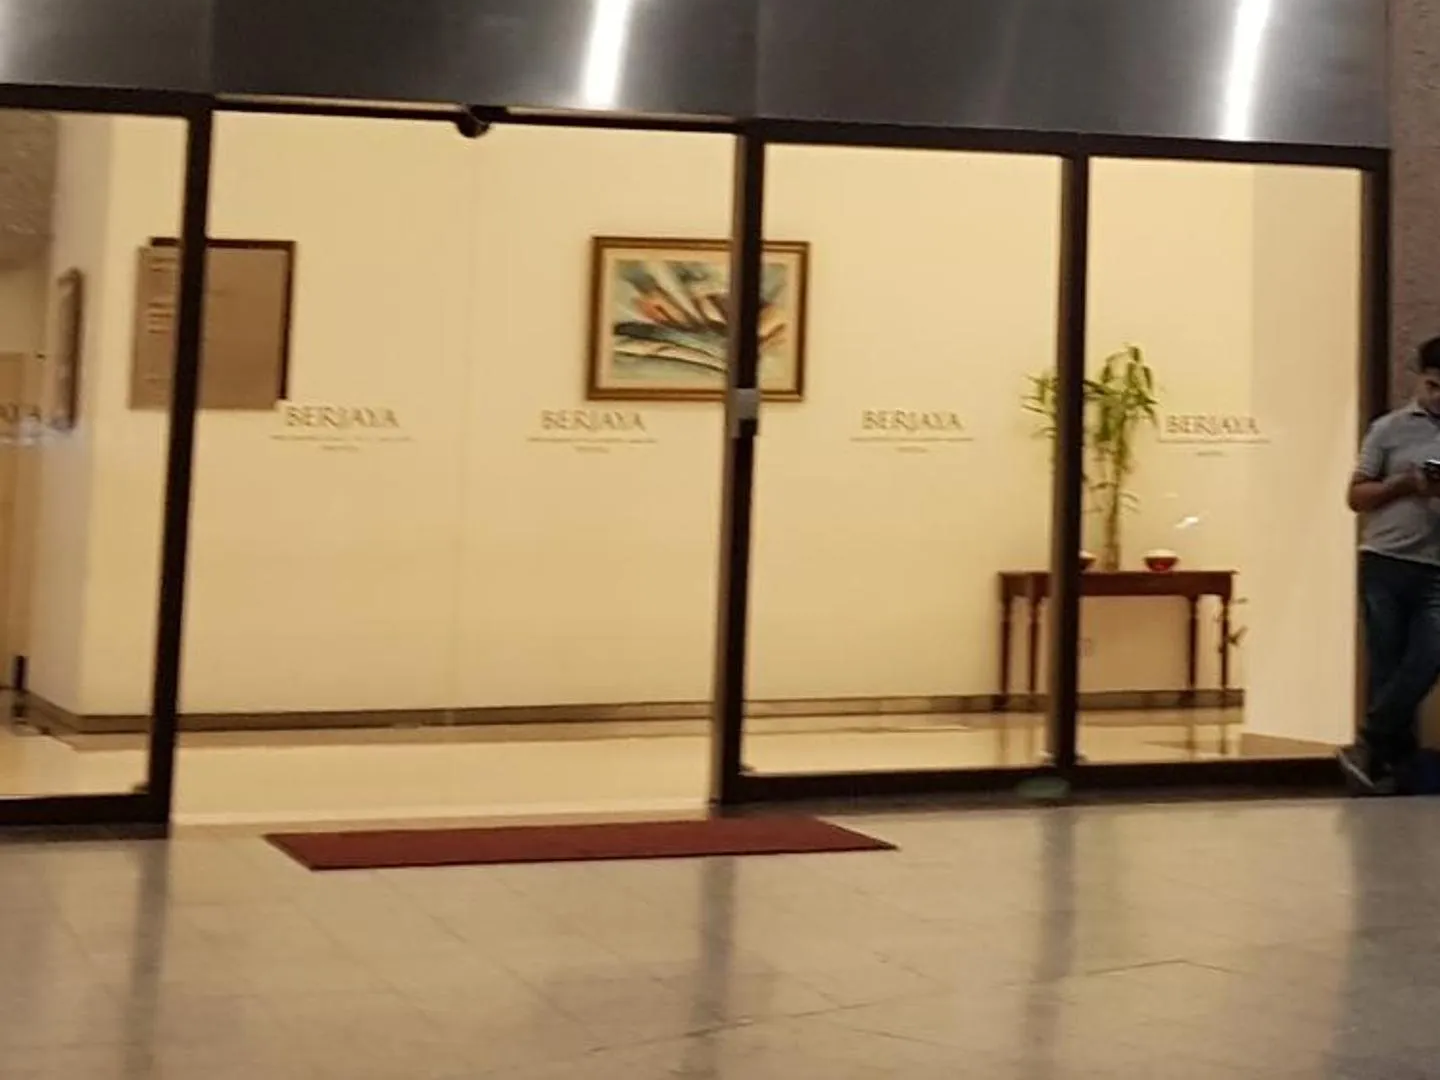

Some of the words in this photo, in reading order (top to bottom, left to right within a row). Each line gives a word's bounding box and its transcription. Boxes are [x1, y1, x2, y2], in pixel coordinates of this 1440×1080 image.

[285, 405, 400, 429] BERJAYA
[540, 409, 648, 432] BERJAYA
[862, 410, 965, 432] BERJAYA
[1166, 414, 1261, 436] BERJAYA
